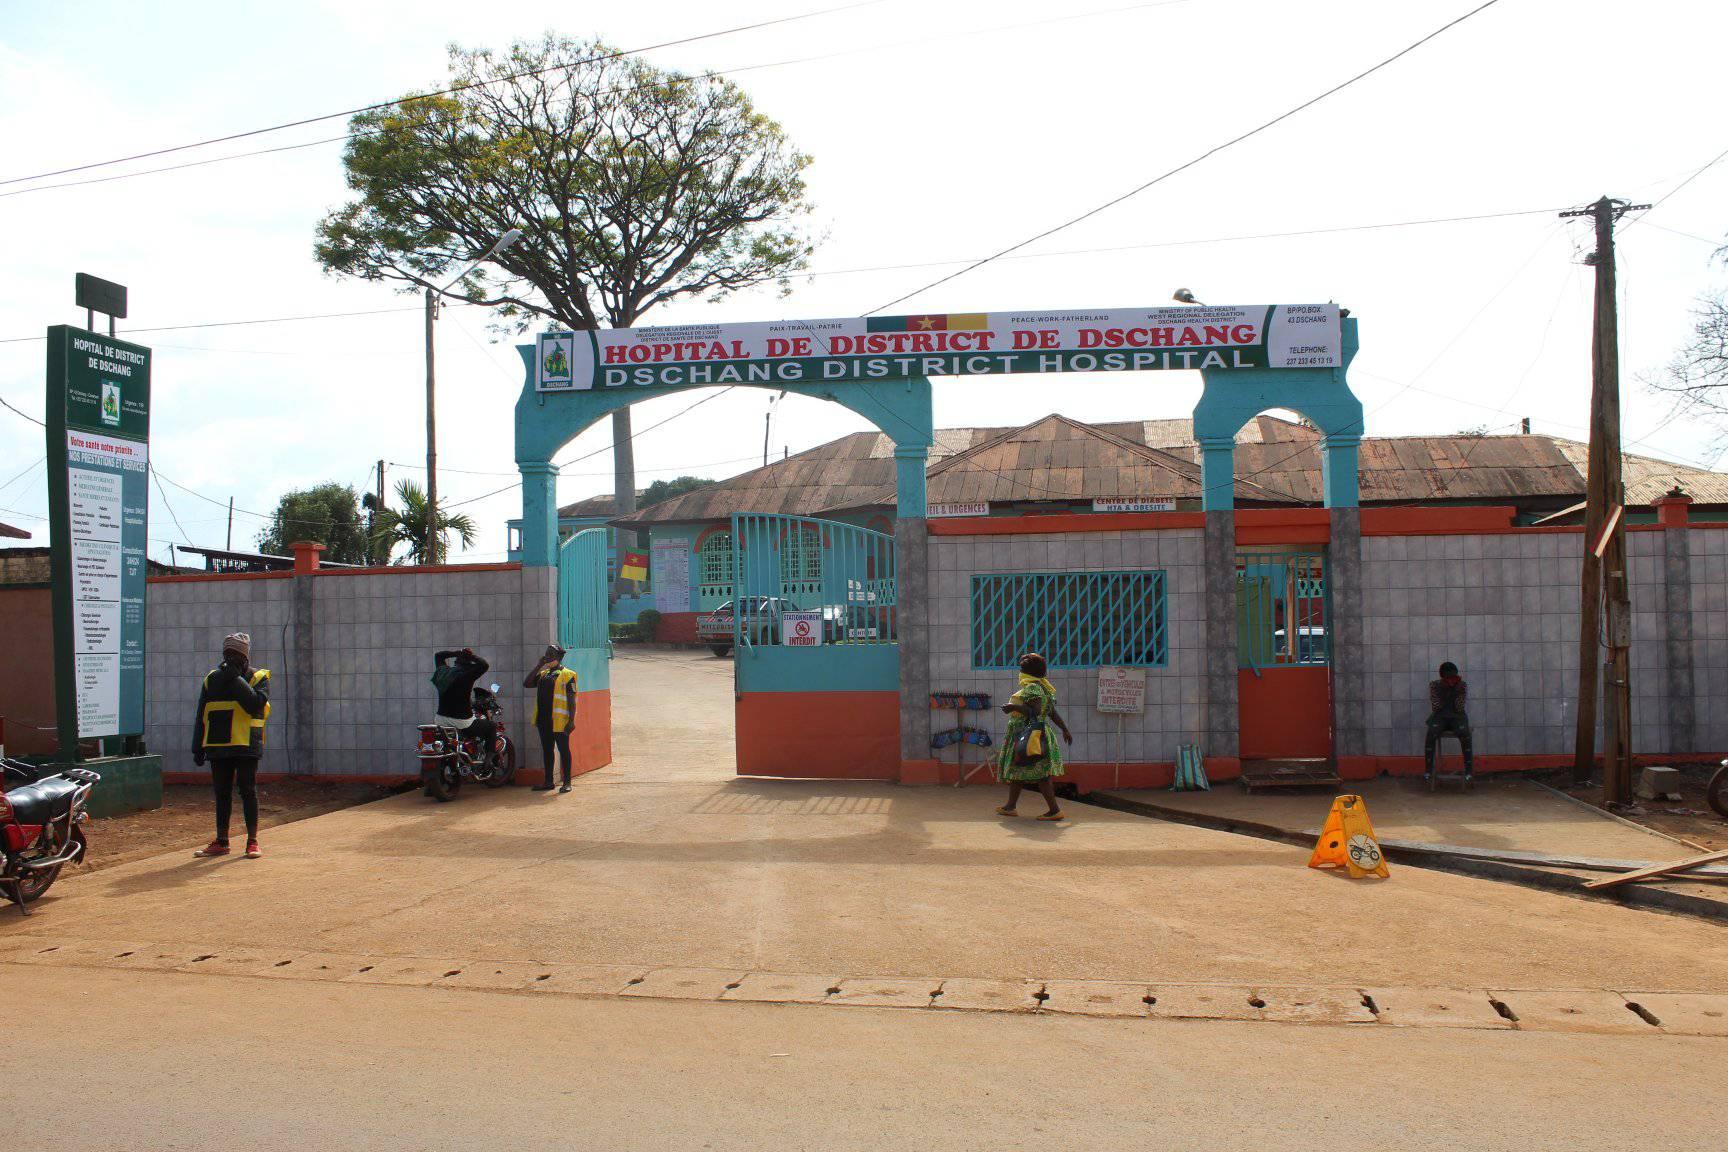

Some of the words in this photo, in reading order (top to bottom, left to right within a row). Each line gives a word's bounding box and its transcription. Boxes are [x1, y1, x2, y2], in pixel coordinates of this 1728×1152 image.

[769, 323, 843, 332] PAIX-TRAVAIL-PATRIE
[1011, 315, 1109, 323] PEACE-WORK-FATHERLAND
[74, 338, 103, 356] HOPITAL
[105, 346, 114, 358] DE
[115, 349, 144, 366] DISTRICT
[605, 340, 750, 364] HOPITAL
[766, 337, 812, 357] DE
[830, 330, 995, 356] DISTRICT
[1012, 329, 1060, 350] DE
[1078, 324, 1256, 348] DSCHANG
[88, 357, 98, 370] DE
[100, 360, 131, 377] DSCHANG
[606, 362, 803, 386] DSCHANG
[824, 356, 1018, 380] DISTRICT
[1040, 350, 1254, 373] HOSPITAL
[71, 437, 84, 448] Votre
[101, 443, 113, 452] notre
[69, 450, 80, 462] NOS
[81, 453, 114, 467] PRESTATIONS
[116, 458, 122, 468] ET
[123, 460, 146, 472] SERVICES
[949, 504, 986, 514] URGENCES
[789, 637, 816, 645] INTERDIT
